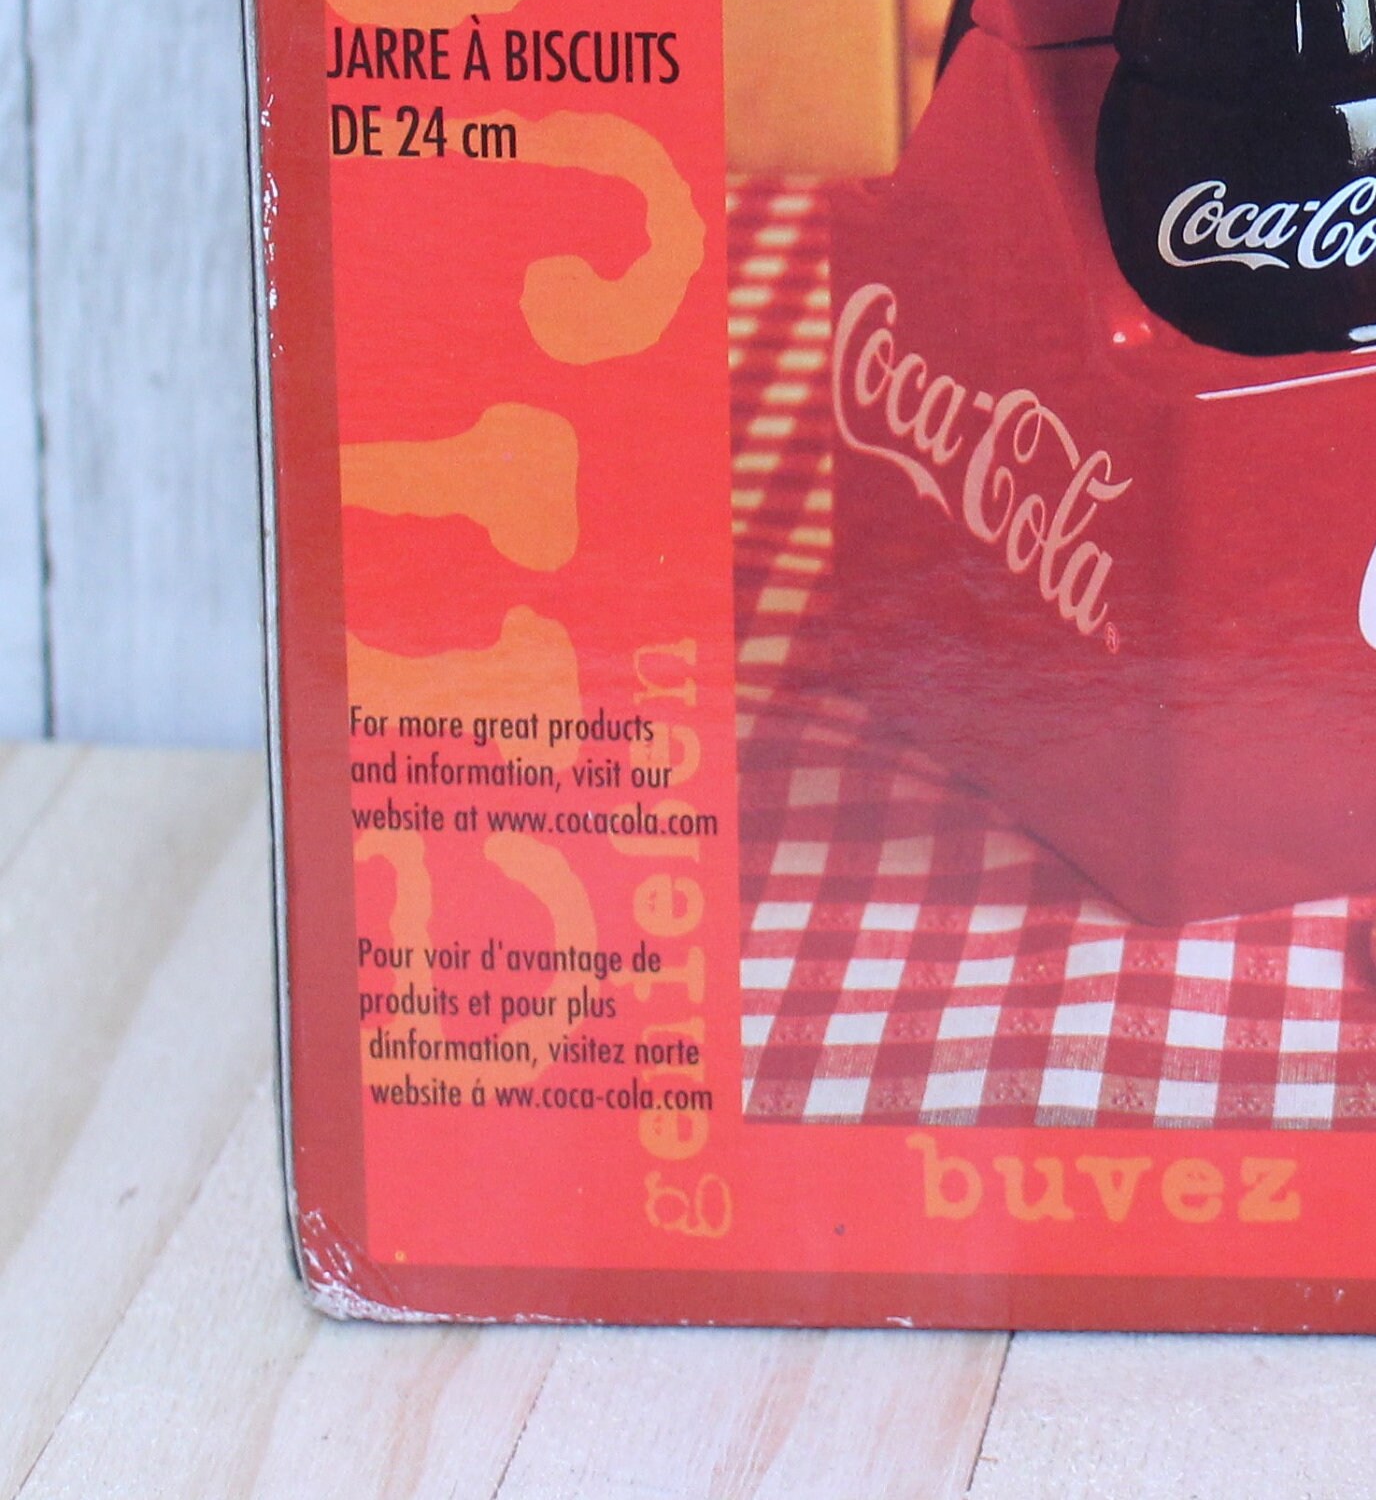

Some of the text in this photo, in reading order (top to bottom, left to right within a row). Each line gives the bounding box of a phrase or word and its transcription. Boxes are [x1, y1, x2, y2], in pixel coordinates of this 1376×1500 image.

[326, 14, 682, 84] JARRE À BISCUITS
[330, 103, 518, 160] DE 24 cm
[832, 282, 1134, 636] Coca-Cola
[350, 705, 655, 748] For more great products
[350, 752, 674, 793] and information, visit our
[351, 798, 719, 837] website at www.cocacola.com
[357, 937, 663, 981] Pour voir d'avantage de
[358, 983, 618, 1025] produits et pour plus
[547, 1035, 626, 1066] visitez
[634, 1037, 701, 1066] norte
[370, 1073, 463, 1108] website
[906, 1134, 1302, 1224] buvez
